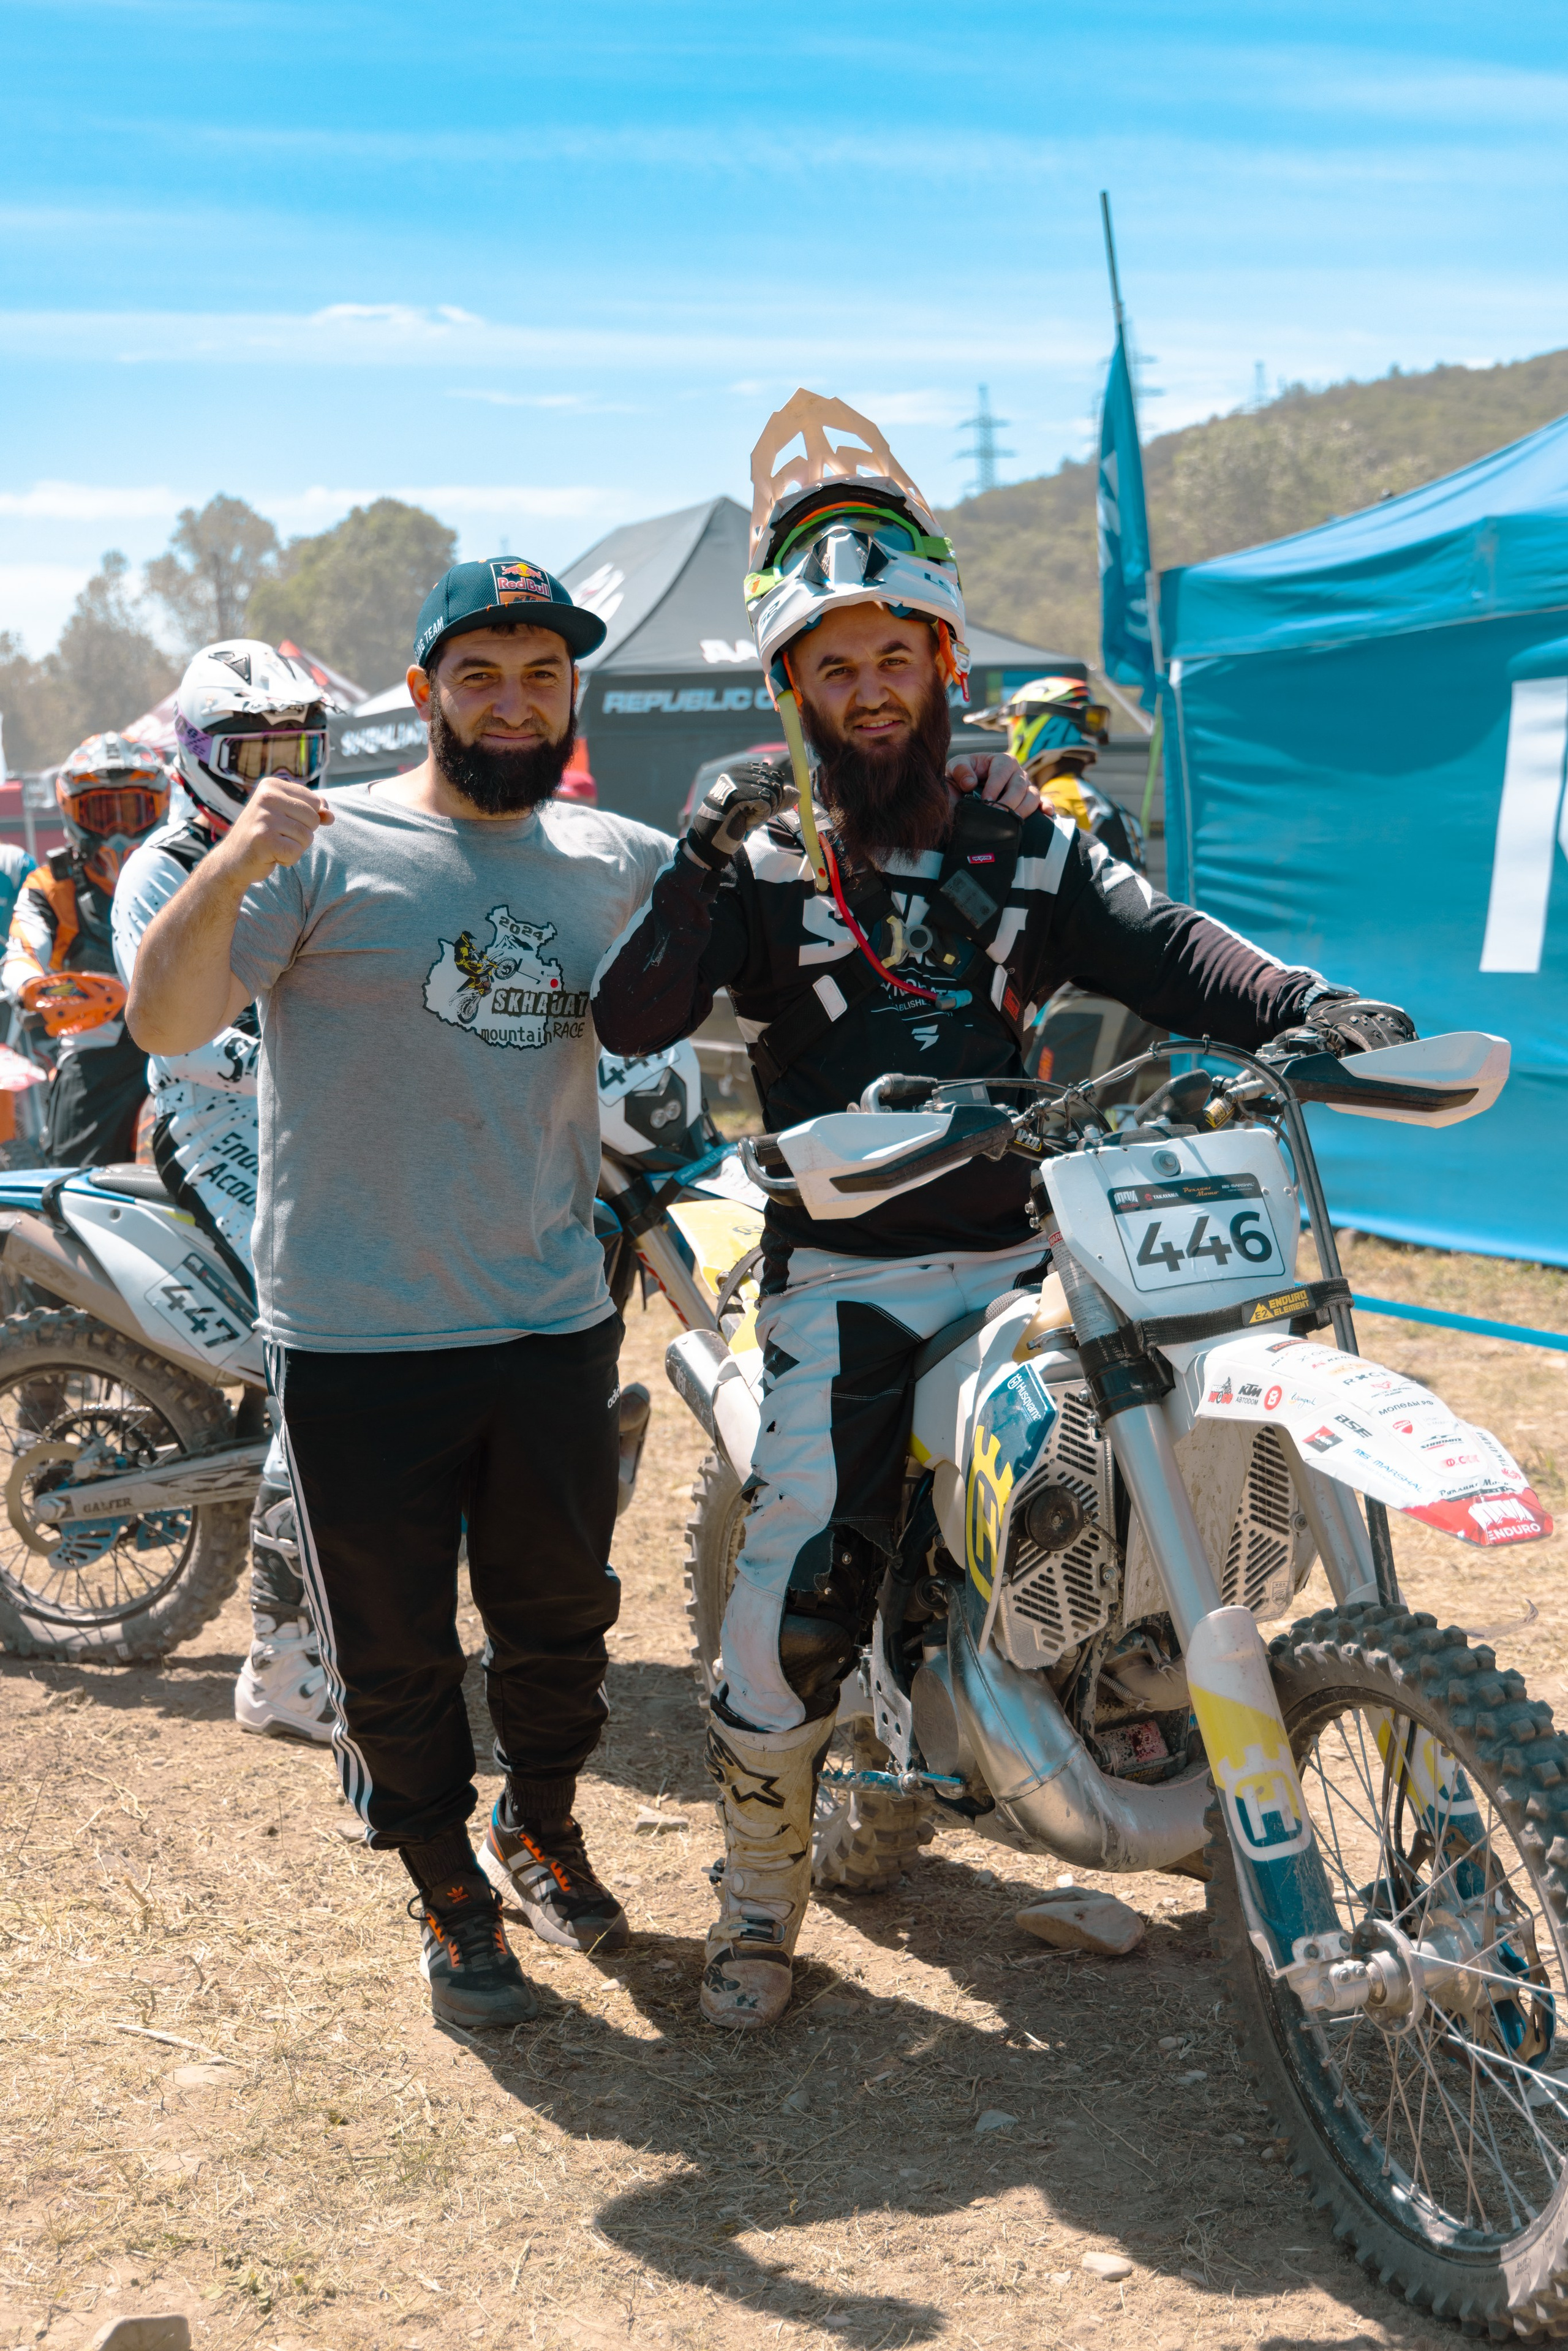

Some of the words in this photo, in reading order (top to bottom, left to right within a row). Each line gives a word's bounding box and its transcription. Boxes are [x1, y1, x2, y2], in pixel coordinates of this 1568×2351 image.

[497, 577, 526, 591] Red
[526, 579, 550, 597] Bull
[423, 616, 444, 644] TEAM
[603, 687, 754, 714] REPUBLIC
[499, 916, 546, 941] 2024
[481, 1026, 552, 1043] mountain
[553, 1022, 585, 1040] RACE
[1153, 1191, 1179, 1200] TAKAYAMA
[1136, 1210, 1272, 1272] 446
[1268, 1290, 1308, 1309] ENDURO
[1273, 1300, 1309, 1316] ELEMENT
[160, 1285, 241, 1349] 447
[1255, 1309, 1268, 1320] E2
[1016, 1381, 1042, 1421] Husqvarna
[1238, 1383, 1262, 1398] KTM
[1353, 1448, 1423, 1493] MS-MARSHAL
[1488, 1523, 1541, 1541] ENDURO
